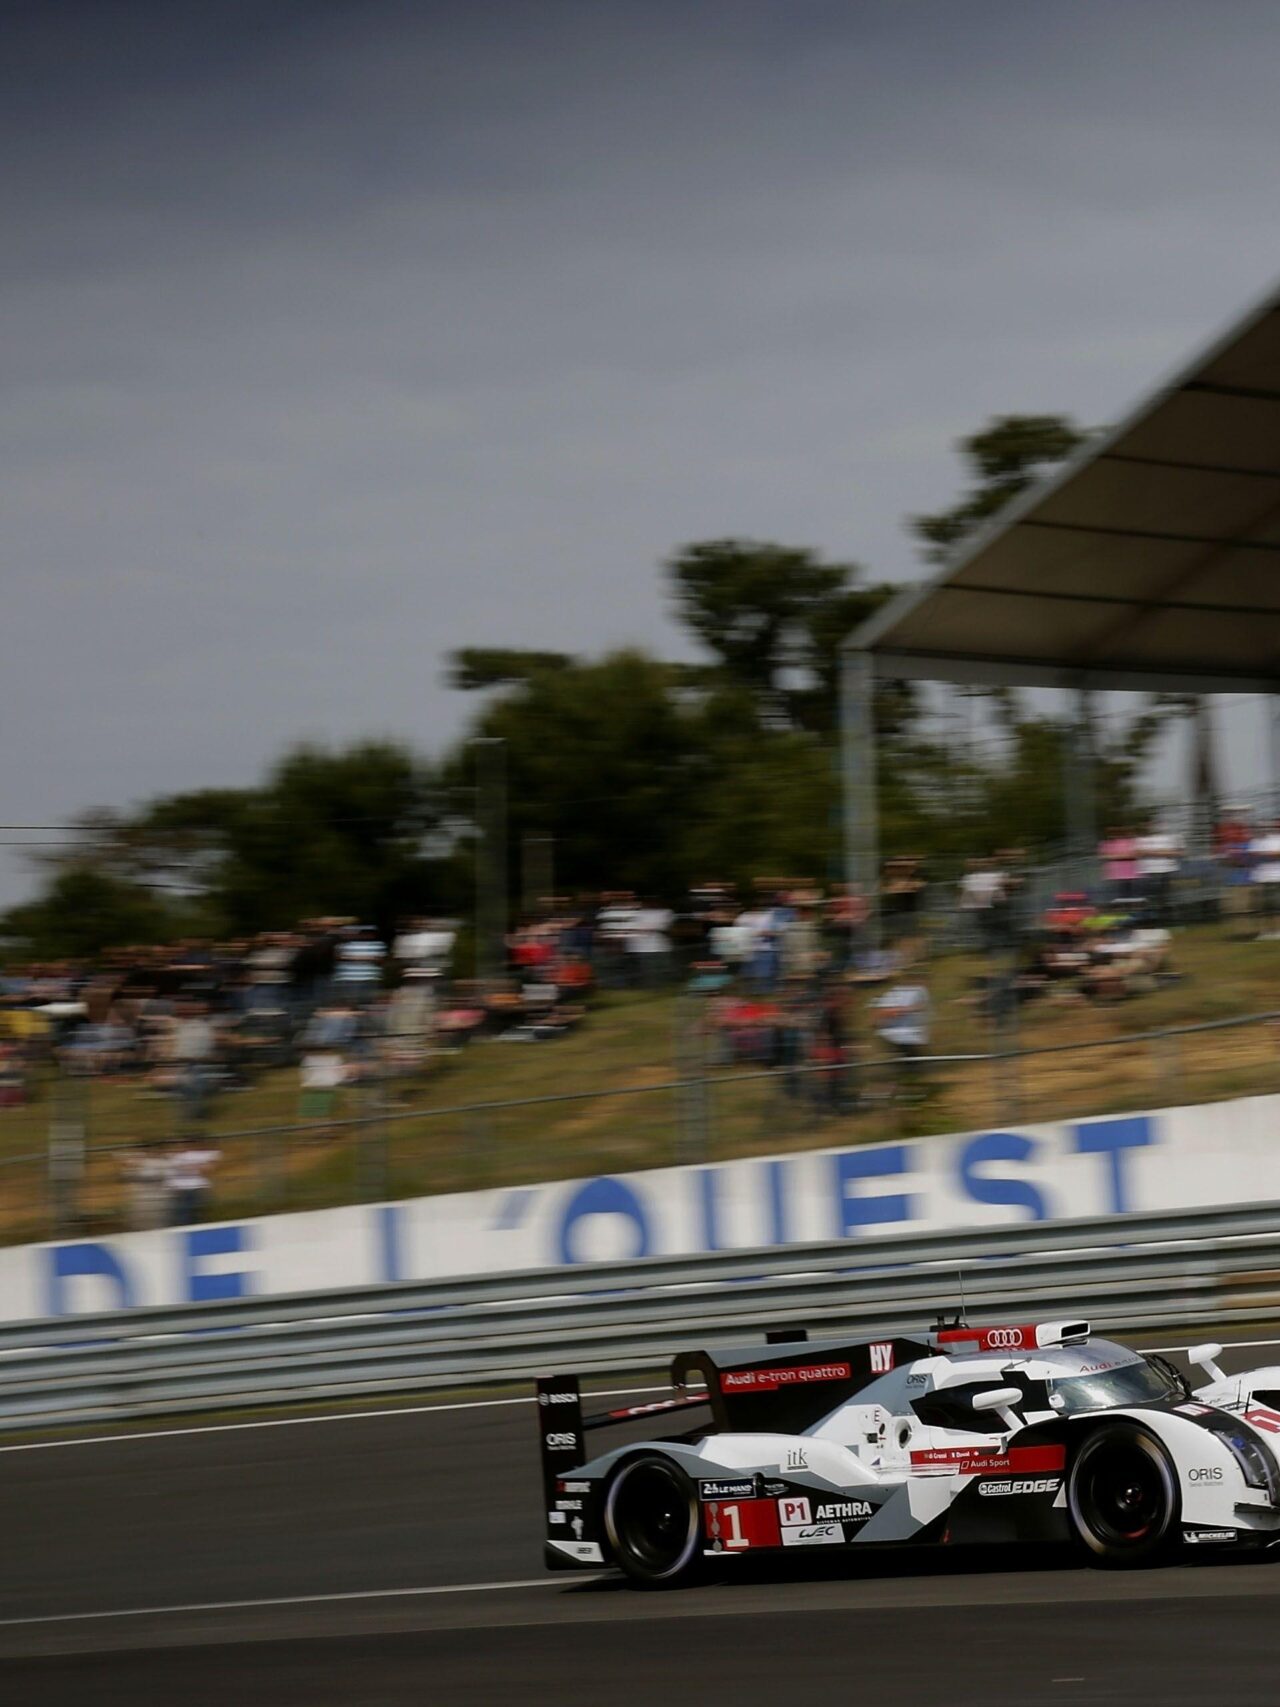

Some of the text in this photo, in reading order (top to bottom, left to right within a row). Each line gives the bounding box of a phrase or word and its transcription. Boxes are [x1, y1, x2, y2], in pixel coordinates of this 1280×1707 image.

[869, 1344, 893, 1371] HY
[725, 1365, 846, 1386] Audi e-tron quattro
[1080, 1362, 1114, 1373] Audi
[907, 1374, 927, 1385] ORIS
[546, 1432, 577, 1445] ORIS
[787, 1448, 808, 1466] itk
[970, 1459, 1010, 1468] Audi Sport
[1188, 1467, 1223, 1481] ORIS
[987, 1478, 1060, 1494] Castrol EDGE
[784, 1502, 806, 1522] P1
[816, 1501, 873, 1519] AETHRA
[723, 1505, 749, 1548] 1
